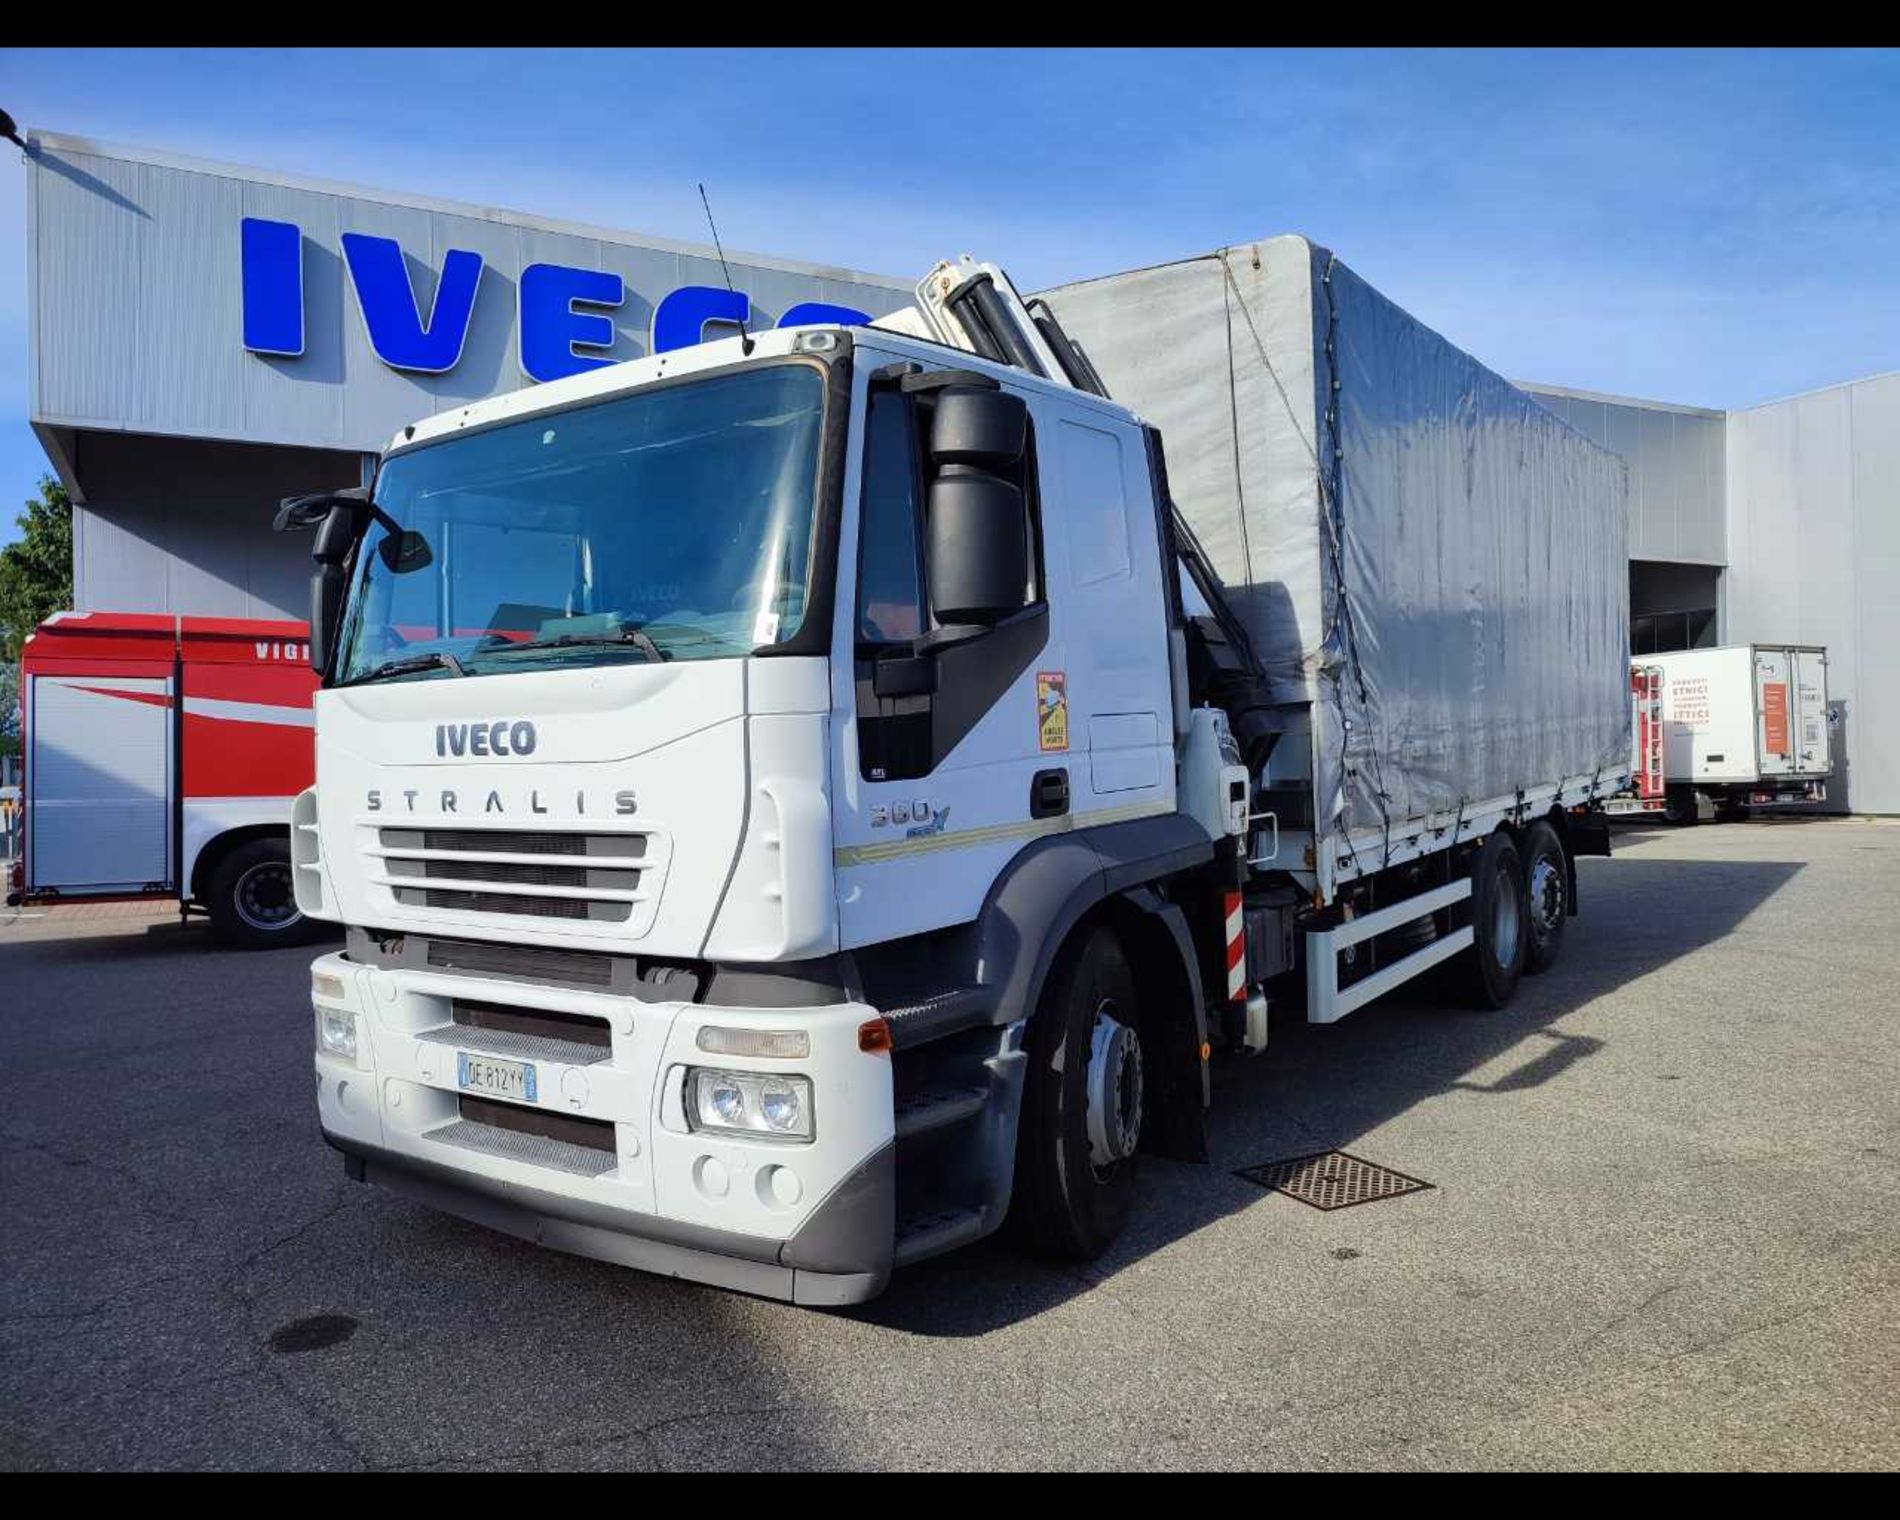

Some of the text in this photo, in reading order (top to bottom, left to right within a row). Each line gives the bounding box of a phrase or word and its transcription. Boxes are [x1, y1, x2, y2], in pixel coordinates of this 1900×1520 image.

[241, 217, 872, 385] IVEC
[435, 721, 537, 757] IVECO
[367, 789, 638, 815] STRALIS
[870, 799, 930, 829] 360
